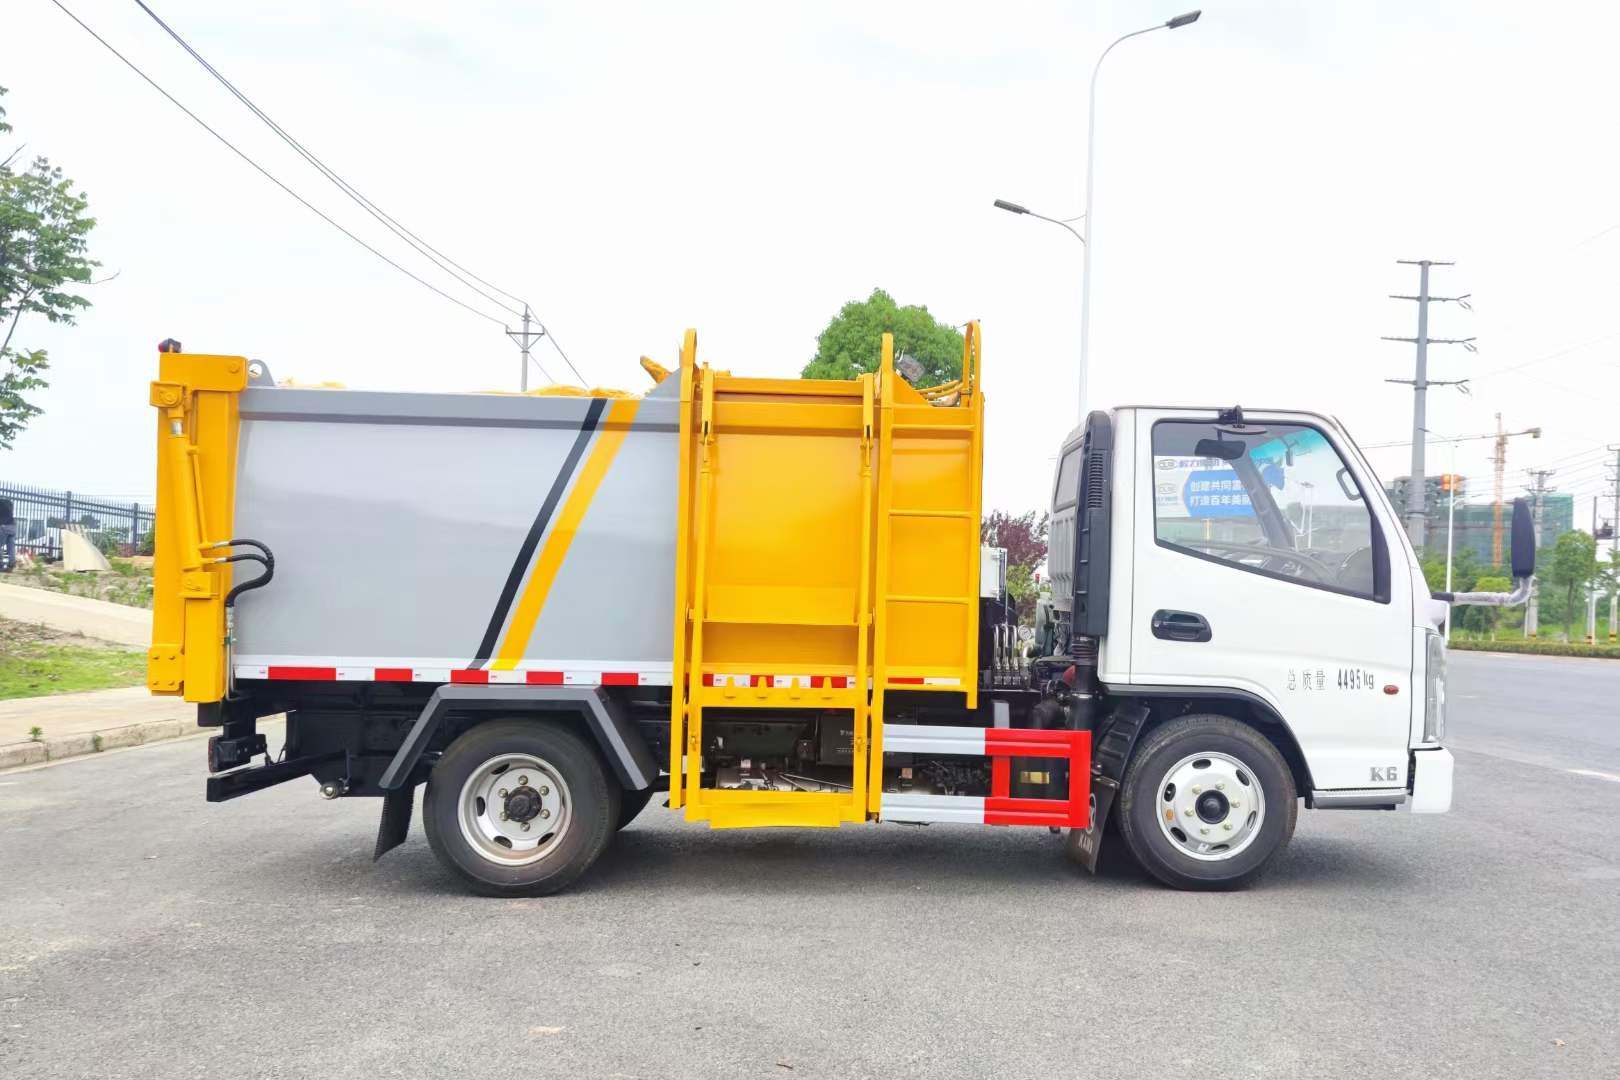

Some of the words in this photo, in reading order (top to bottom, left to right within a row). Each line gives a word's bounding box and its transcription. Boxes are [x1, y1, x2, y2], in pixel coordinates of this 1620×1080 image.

[1287, 667, 1325, 691] 总质量
[1370, 766, 1397, 782] K6
